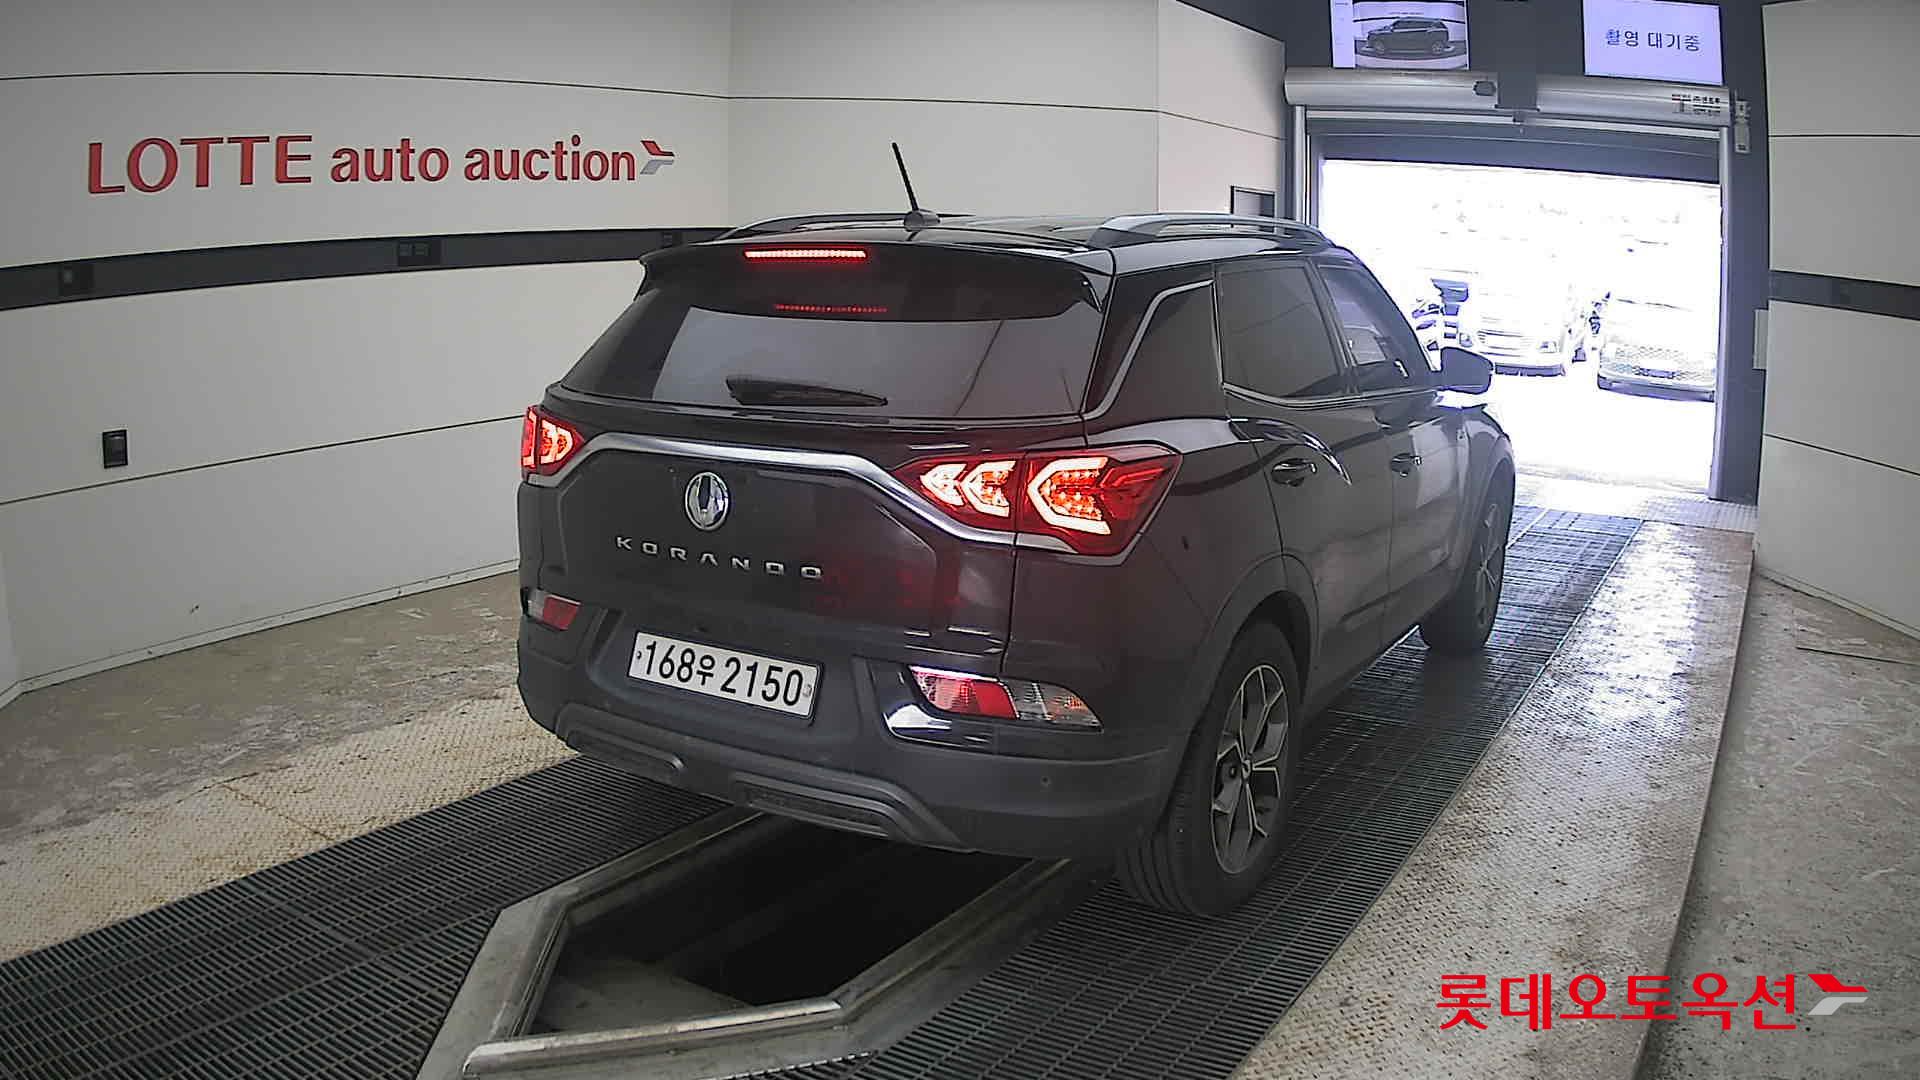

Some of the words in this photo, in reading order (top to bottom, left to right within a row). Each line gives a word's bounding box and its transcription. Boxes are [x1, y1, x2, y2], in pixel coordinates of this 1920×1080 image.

[1647, 32, 1699, 52] 대기중
[88, 135, 312, 193] LOTTE
[330, 138, 450, 182] auto
[464, 134, 636, 181] auction
[616, 536, 822, 579] KORANDO
